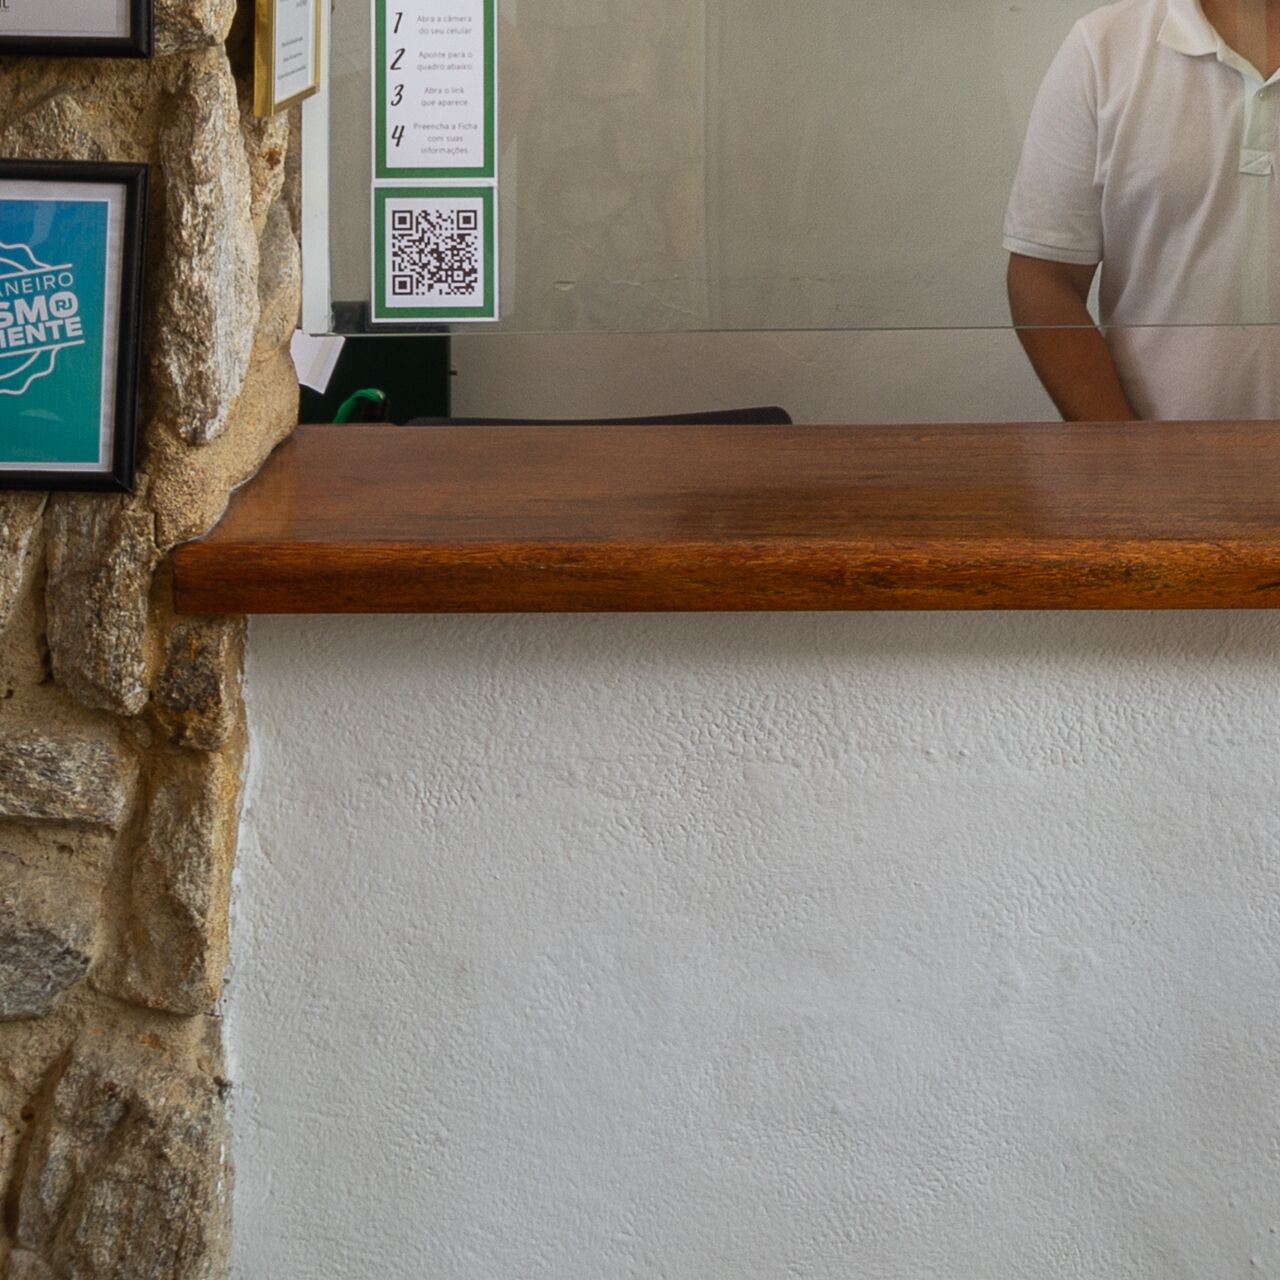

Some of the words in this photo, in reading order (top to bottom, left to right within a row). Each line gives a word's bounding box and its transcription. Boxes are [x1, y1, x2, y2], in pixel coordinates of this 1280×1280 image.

[393, 12, 403, 34] 1
[390, 48, 405, 70] 2
[390, 84, 404, 106] 3
[392, 125, 405, 147] 4
[421, 147, 468, 155] informações
